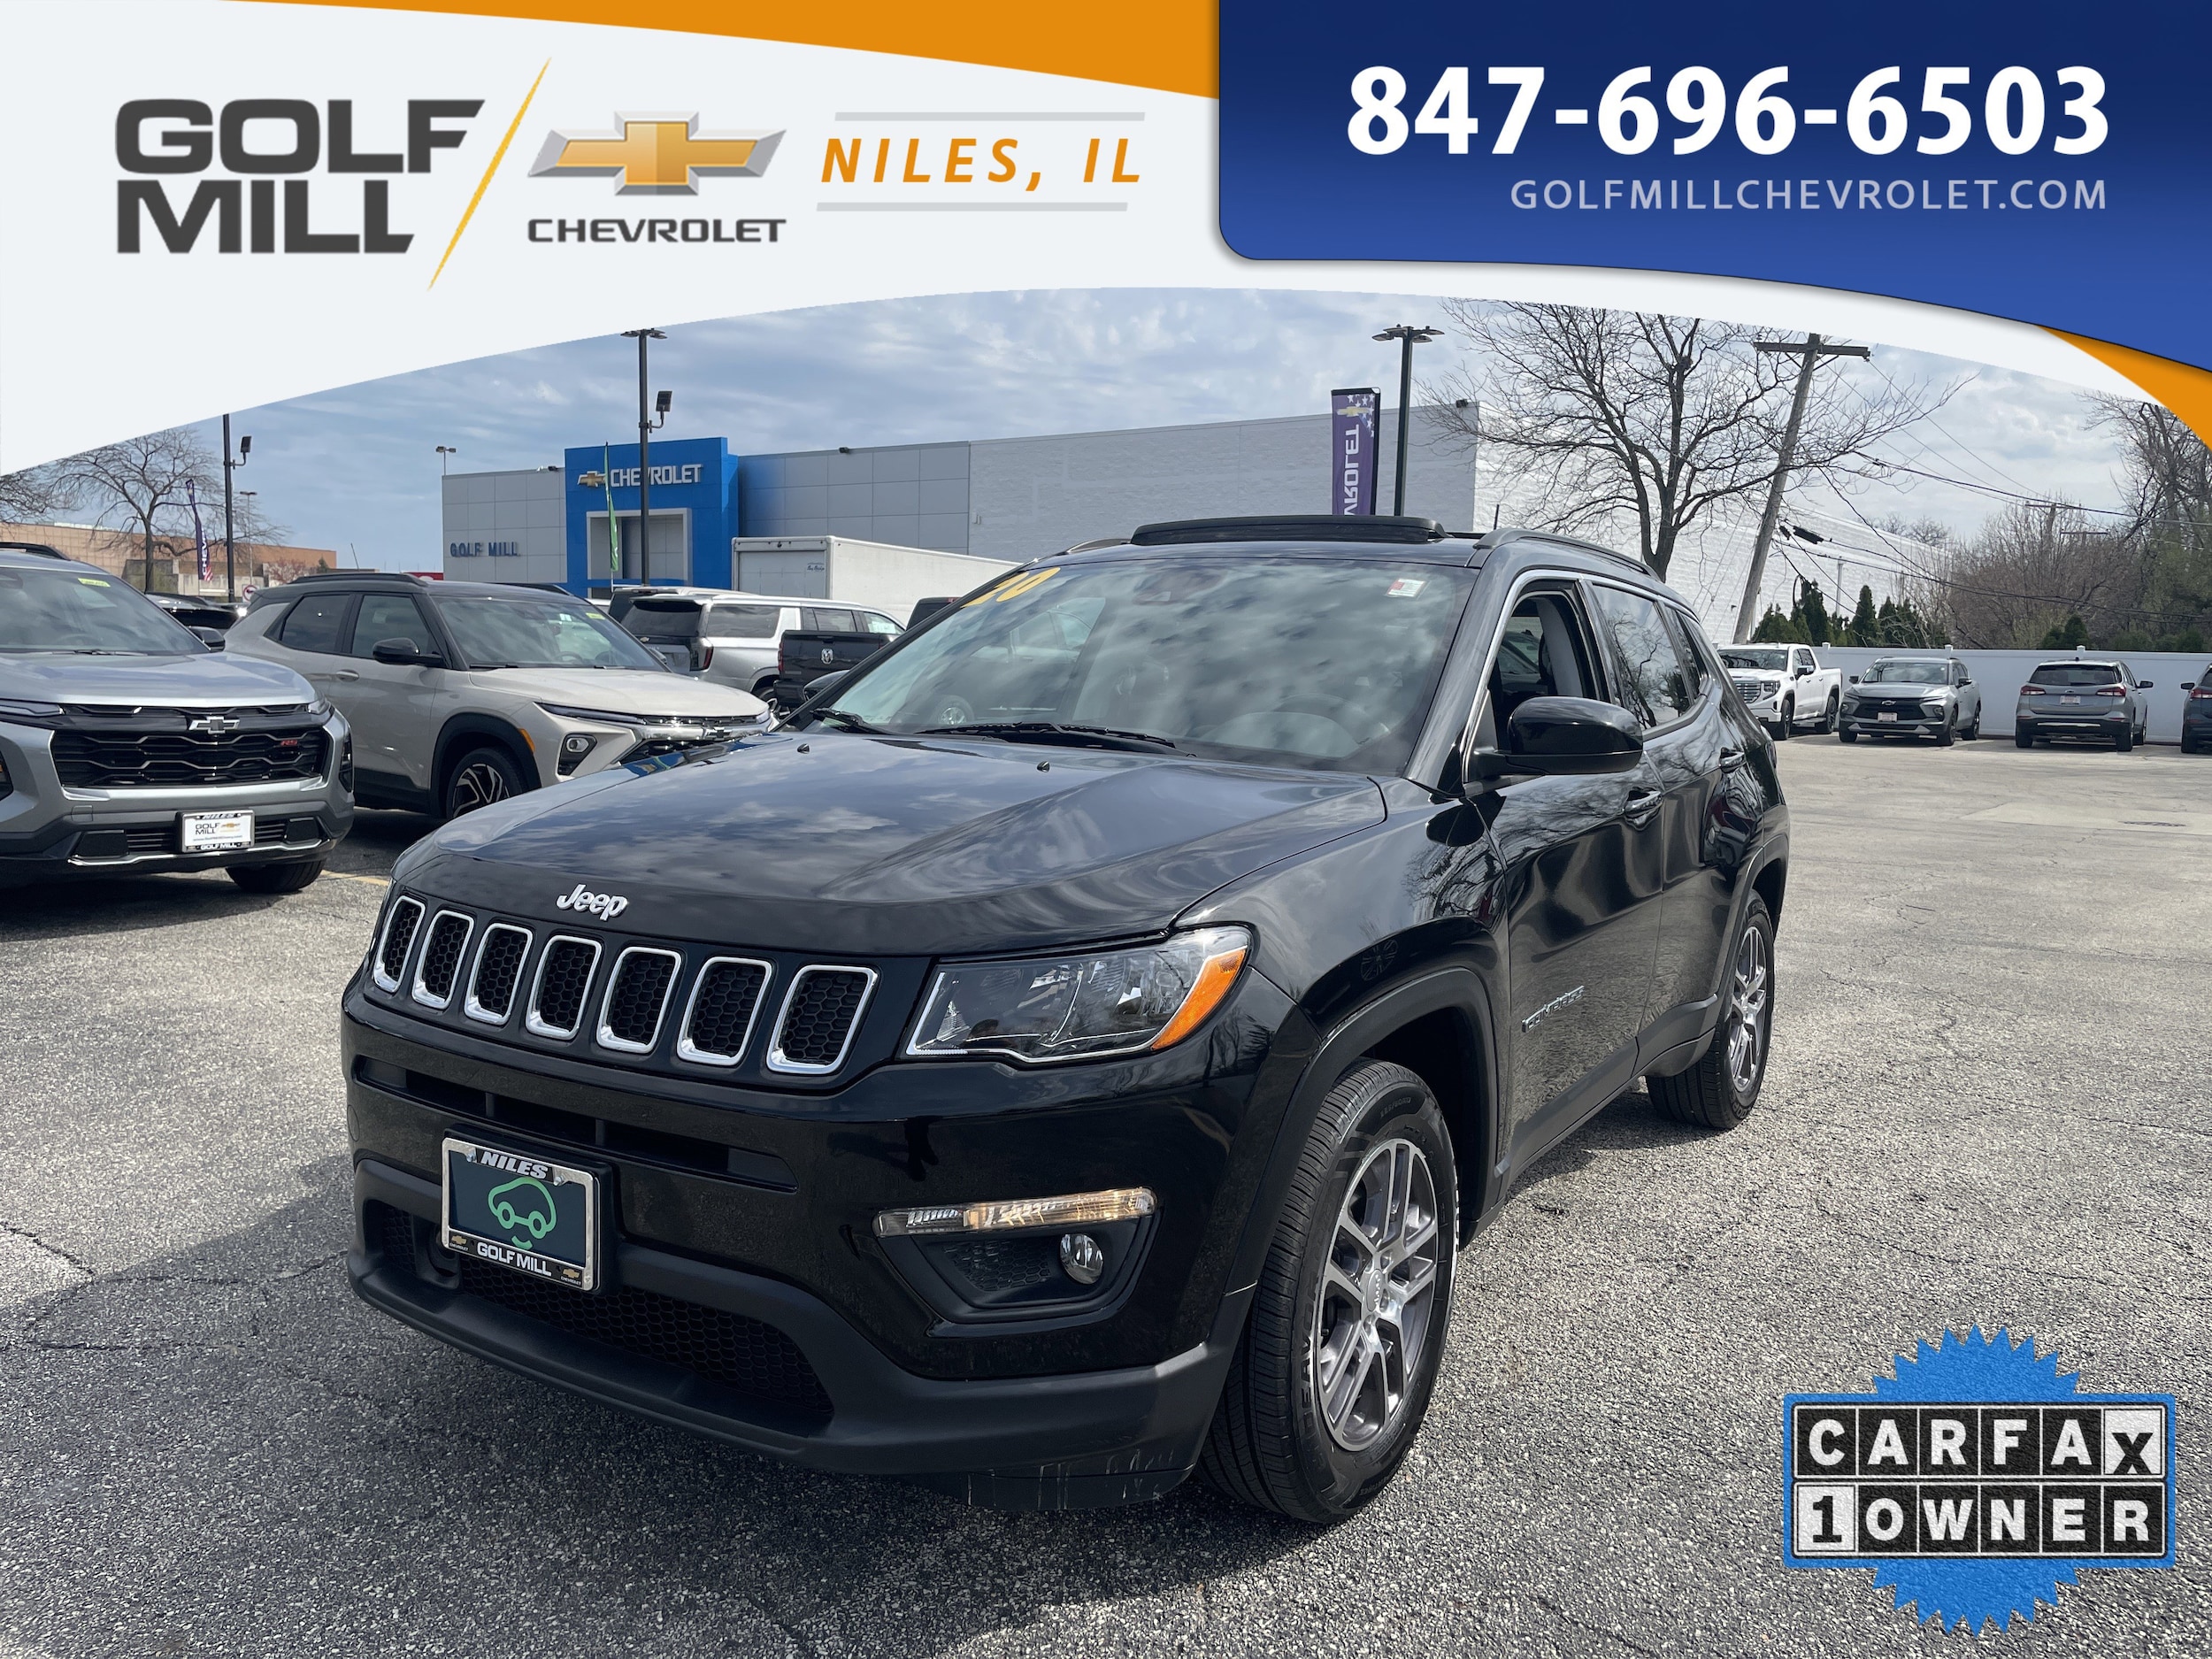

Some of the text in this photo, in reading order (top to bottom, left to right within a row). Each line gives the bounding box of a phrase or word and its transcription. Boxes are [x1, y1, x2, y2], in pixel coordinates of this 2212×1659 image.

[610, 464, 703, 488] CHEROLET
[450, 541, 519, 557] GOLF MILL
[557, 884, 628, 921] Jeep
[481, 1151, 549, 1179] NILES
[477, 1241, 552, 1277] GOLF MILL
